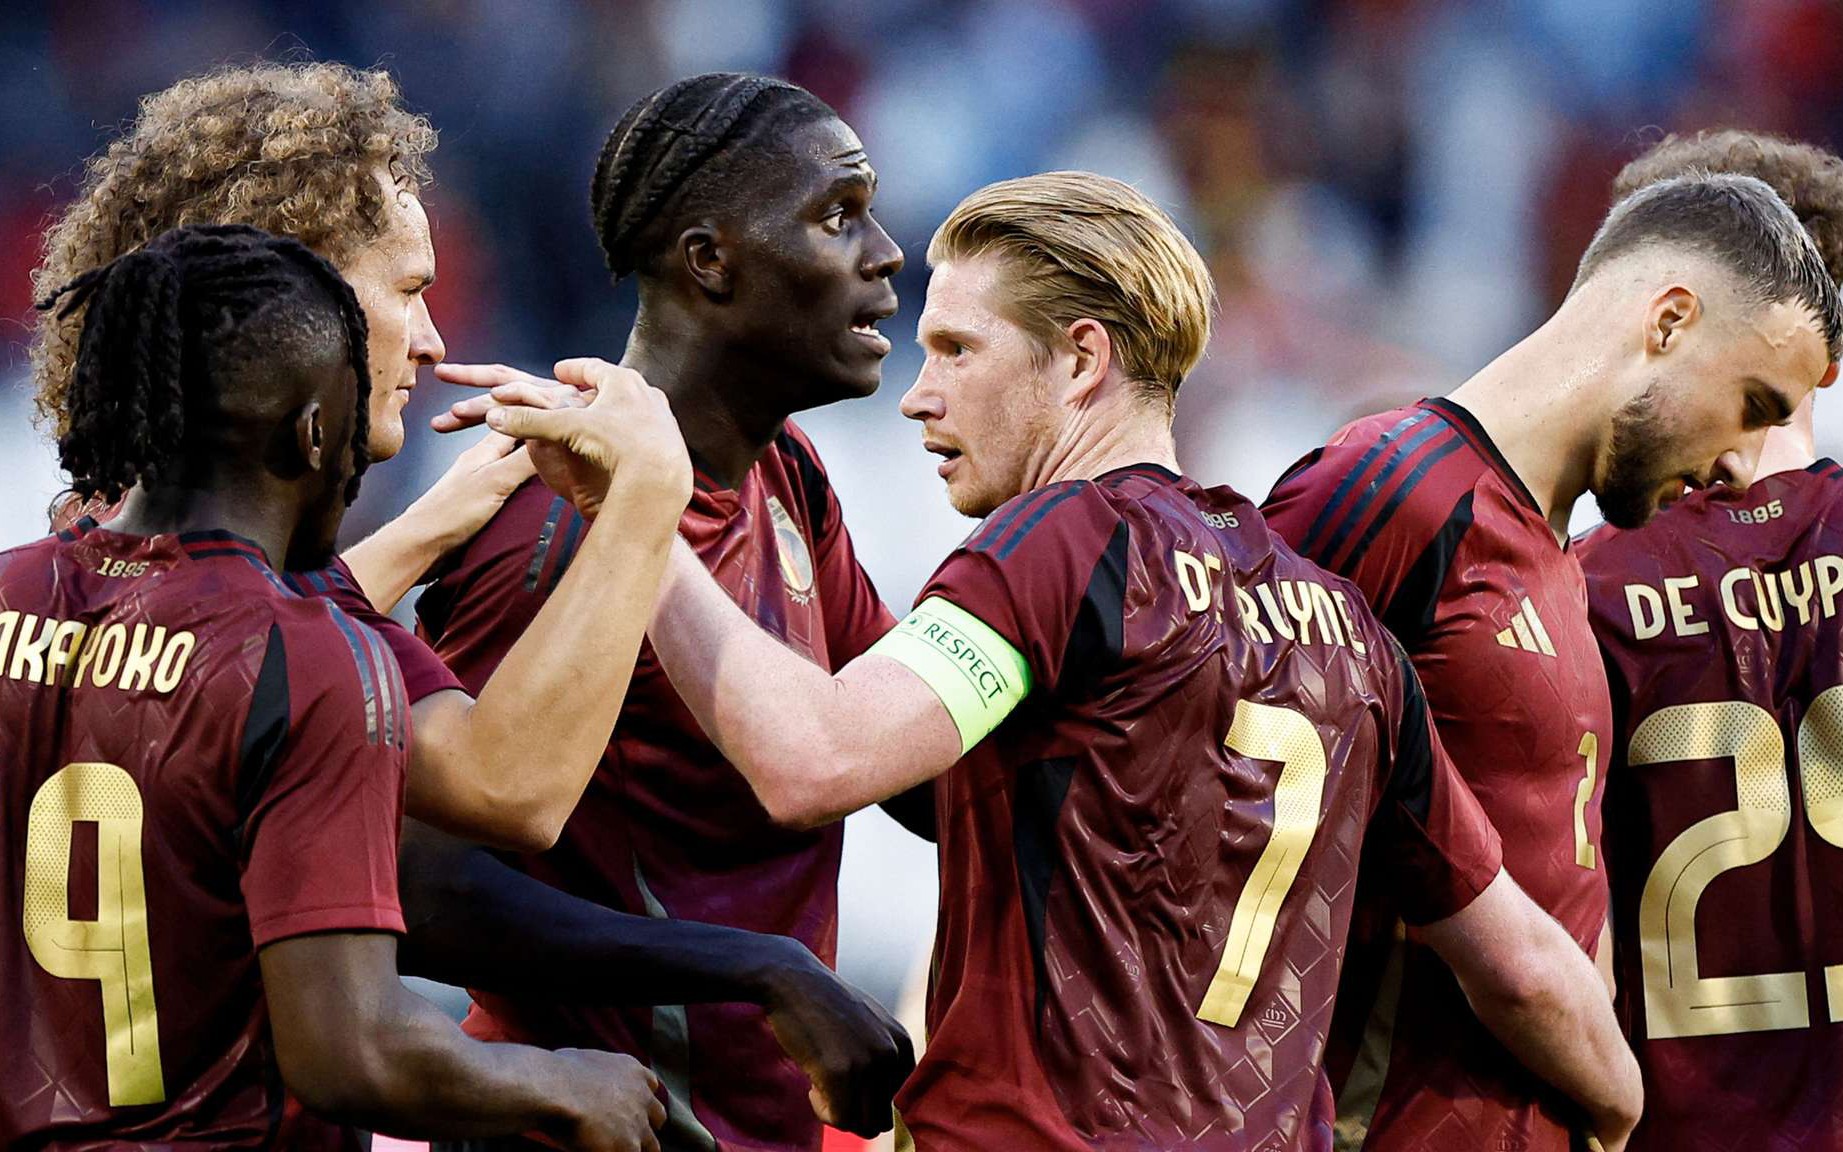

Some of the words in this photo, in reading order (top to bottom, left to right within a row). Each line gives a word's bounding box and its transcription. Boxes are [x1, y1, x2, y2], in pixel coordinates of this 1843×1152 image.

[1201, 510, 1239, 530] 895
[1727, 499, 1783, 524] 1895
[97, 557, 149, 577] 1895
[1624, 575, 1709, 640] DE
[1720, 555, 1843, 631] CUYP
[924, 623, 1003, 699] RESPECT
[1196, 699, 1327, 1028] 7
[23, 762, 166, 1107] 9
